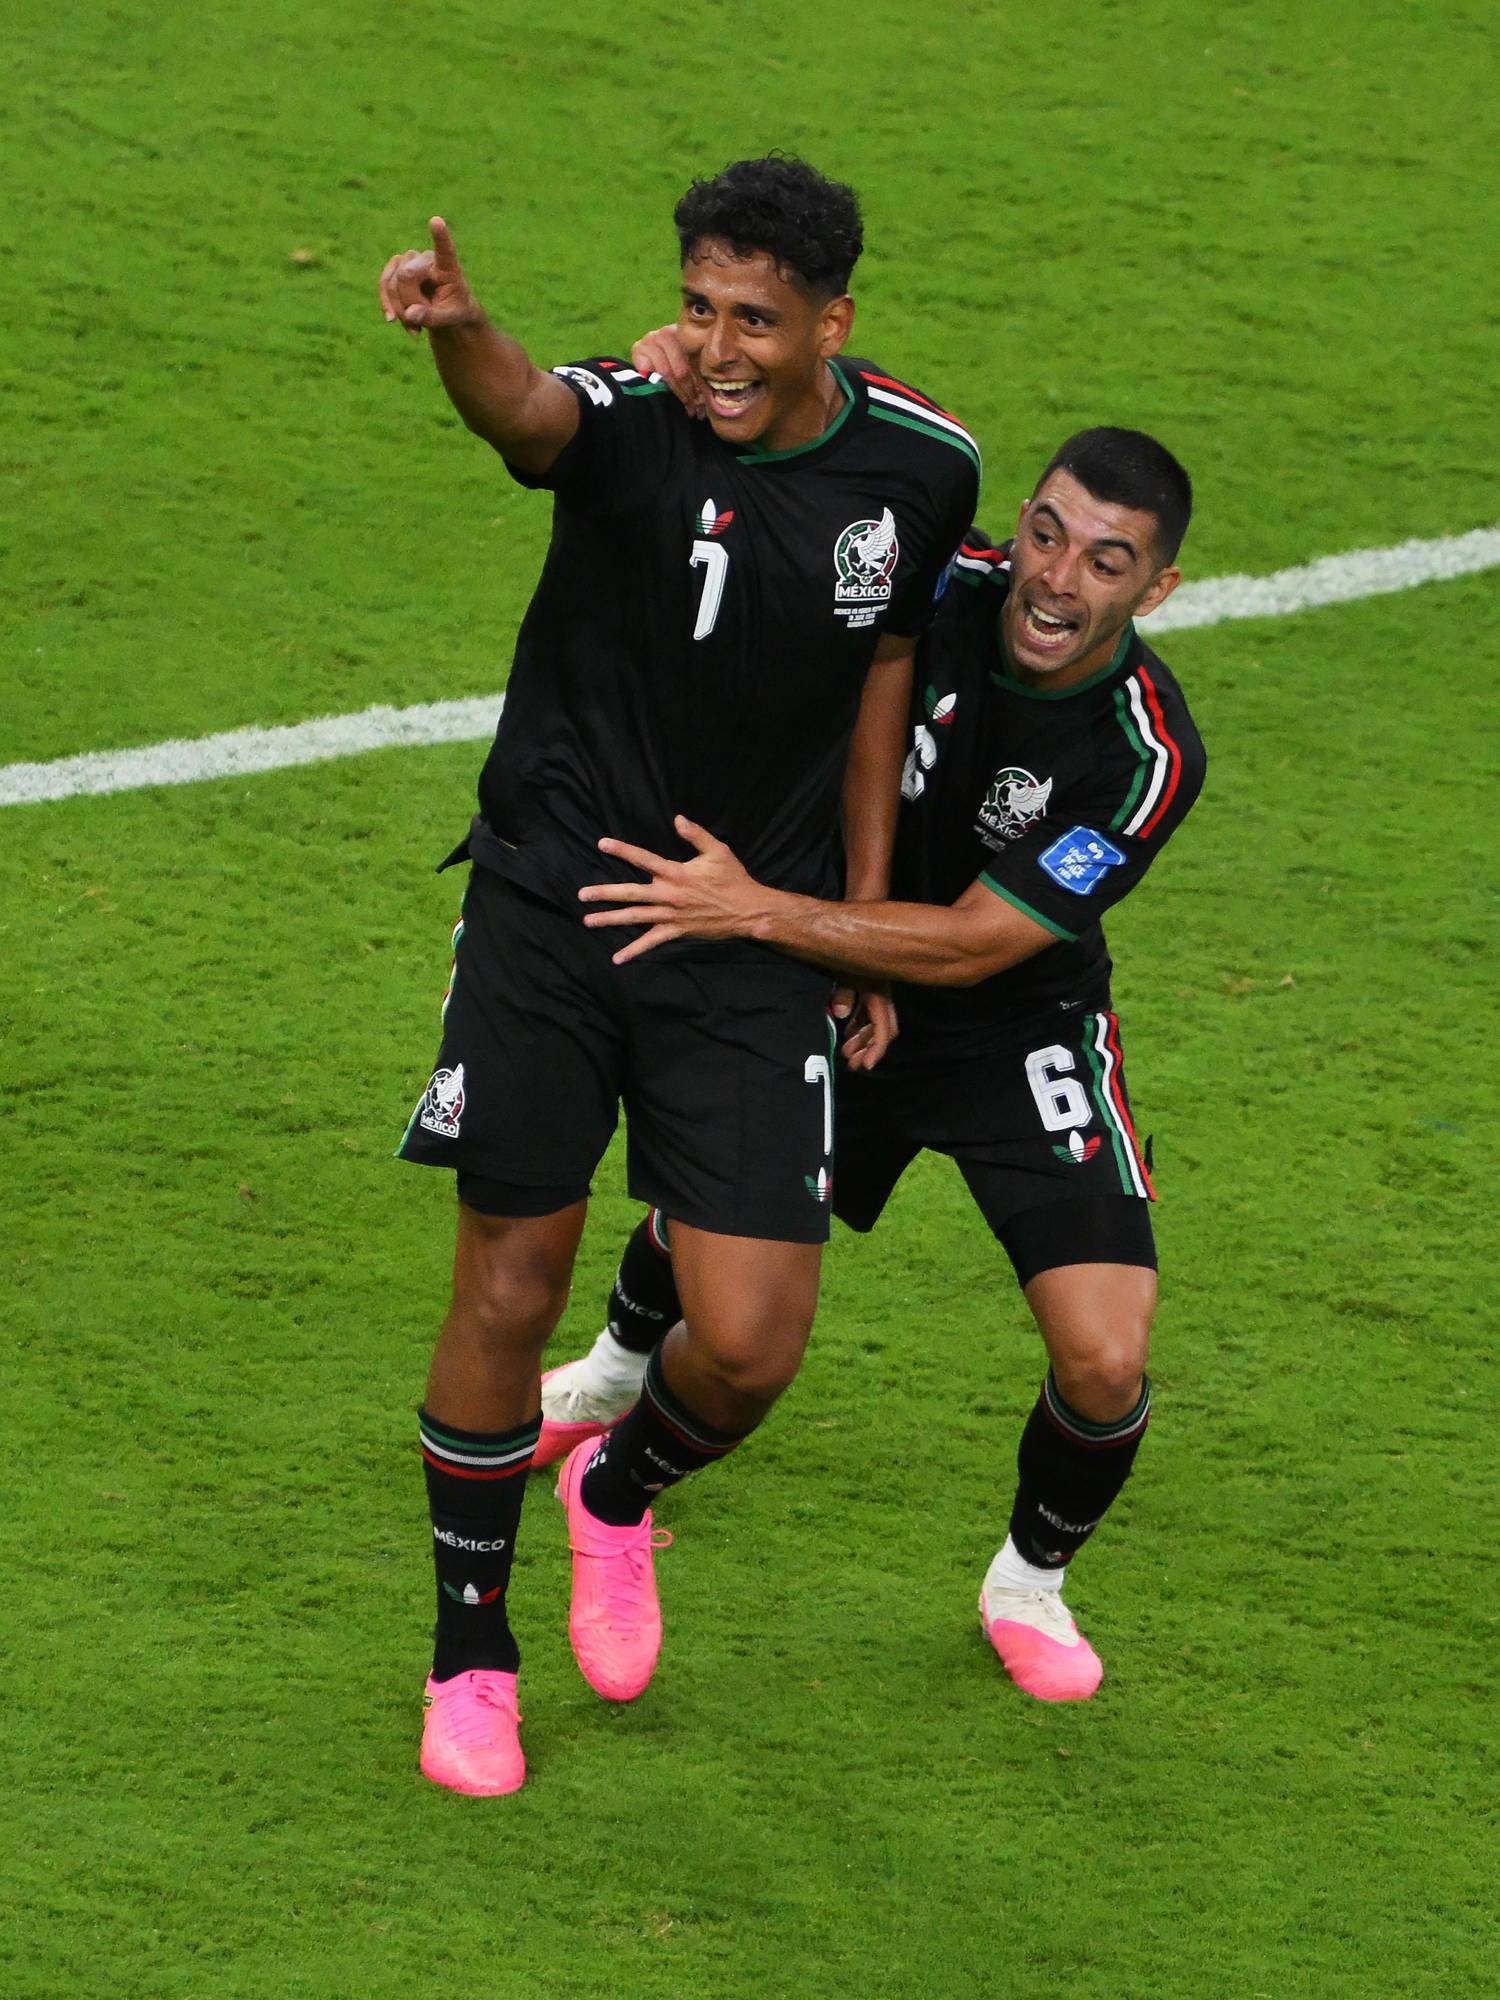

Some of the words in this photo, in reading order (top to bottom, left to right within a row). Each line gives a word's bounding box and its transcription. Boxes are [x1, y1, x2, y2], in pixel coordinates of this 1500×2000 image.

[689, 540, 729, 640] 7
[838, 583, 889, 598] MÉXICO
[978, 807, 1025, 839] MÉXIC
[1024, 1044, 1093, 1132] 6
[433, 1526, 505, 1552] MÉXICO
